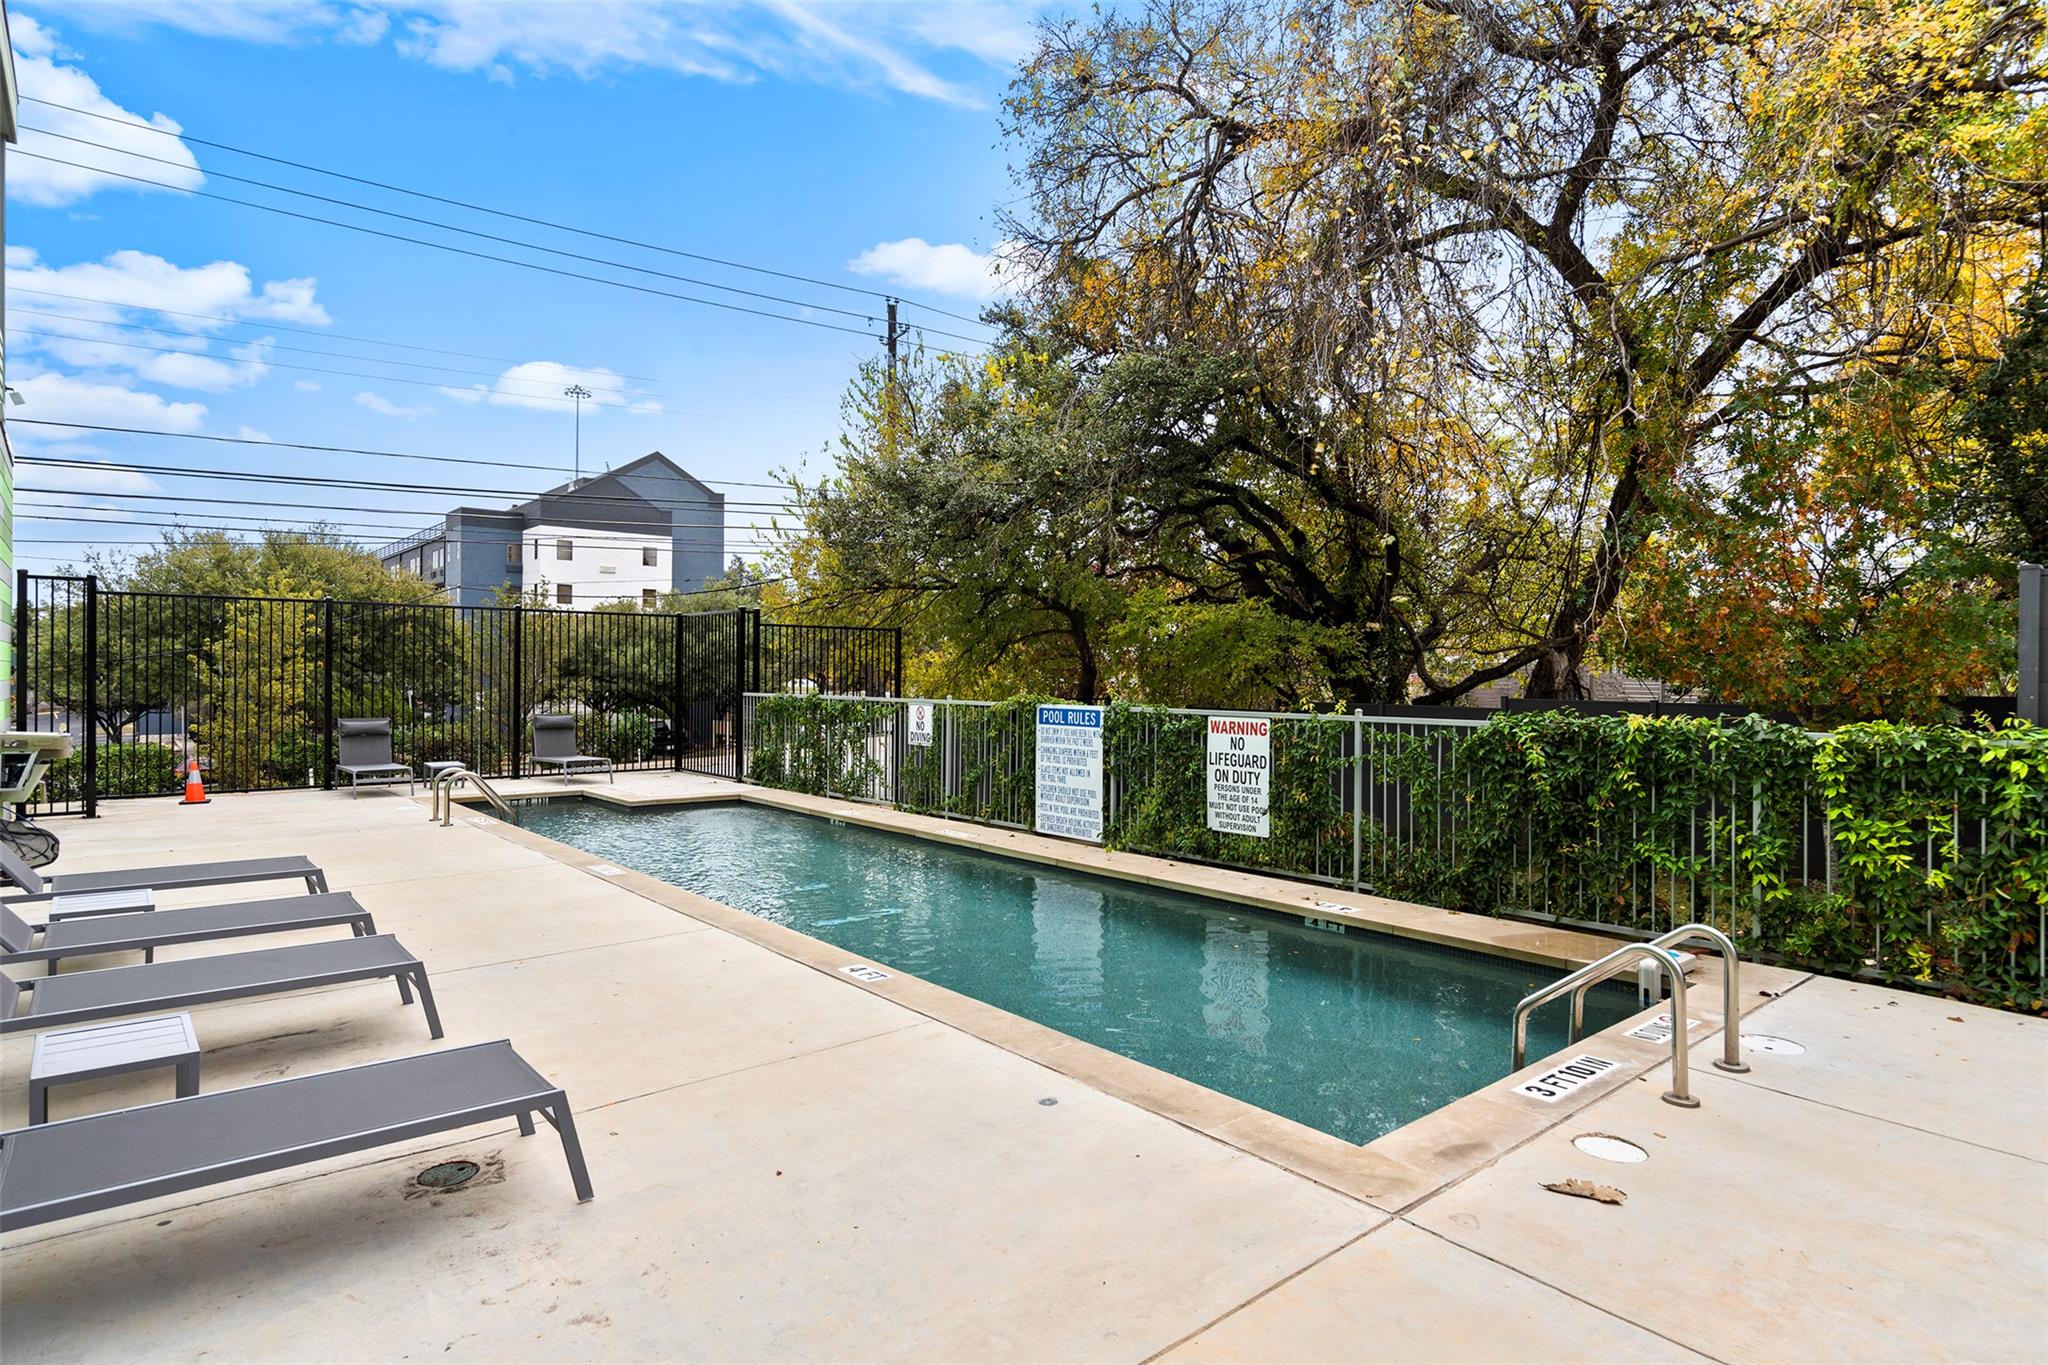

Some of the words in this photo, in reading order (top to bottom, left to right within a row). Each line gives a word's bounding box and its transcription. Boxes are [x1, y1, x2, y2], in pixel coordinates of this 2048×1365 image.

[1043, 710, 1064, 723] POOL
[1068, 712, 1096, 725] RULES
[916, 721, 924, 731] NO
[1211, 720, 1267, 736] WARNING
[911, 731, 931, 742] DIVING
[1230, 737, 1245, 751] NO
[1210, 752, 1266, 769] LIFEGUARD
[1215, 769, 1228, 782] ON
[1233, 770, 1260, 785] DUTY
[1214, 784, 1240, 793] PERSONS
[1241, 786, 1261, 795] UNDER
[1218, 793, 1228, 801] THE
[1209, 801, 1224, 810] MUST
[1239, 805, 1250, 813] USE
[1215, 811, 1240, 820] WITHOUT
[1242, 815, 1260, 823] ADULT
[1219, 821, 1256, 832] SUPERVISION
[858, 971, 888, 980] FT
[1525, 1086, 1556, 1097] 3
